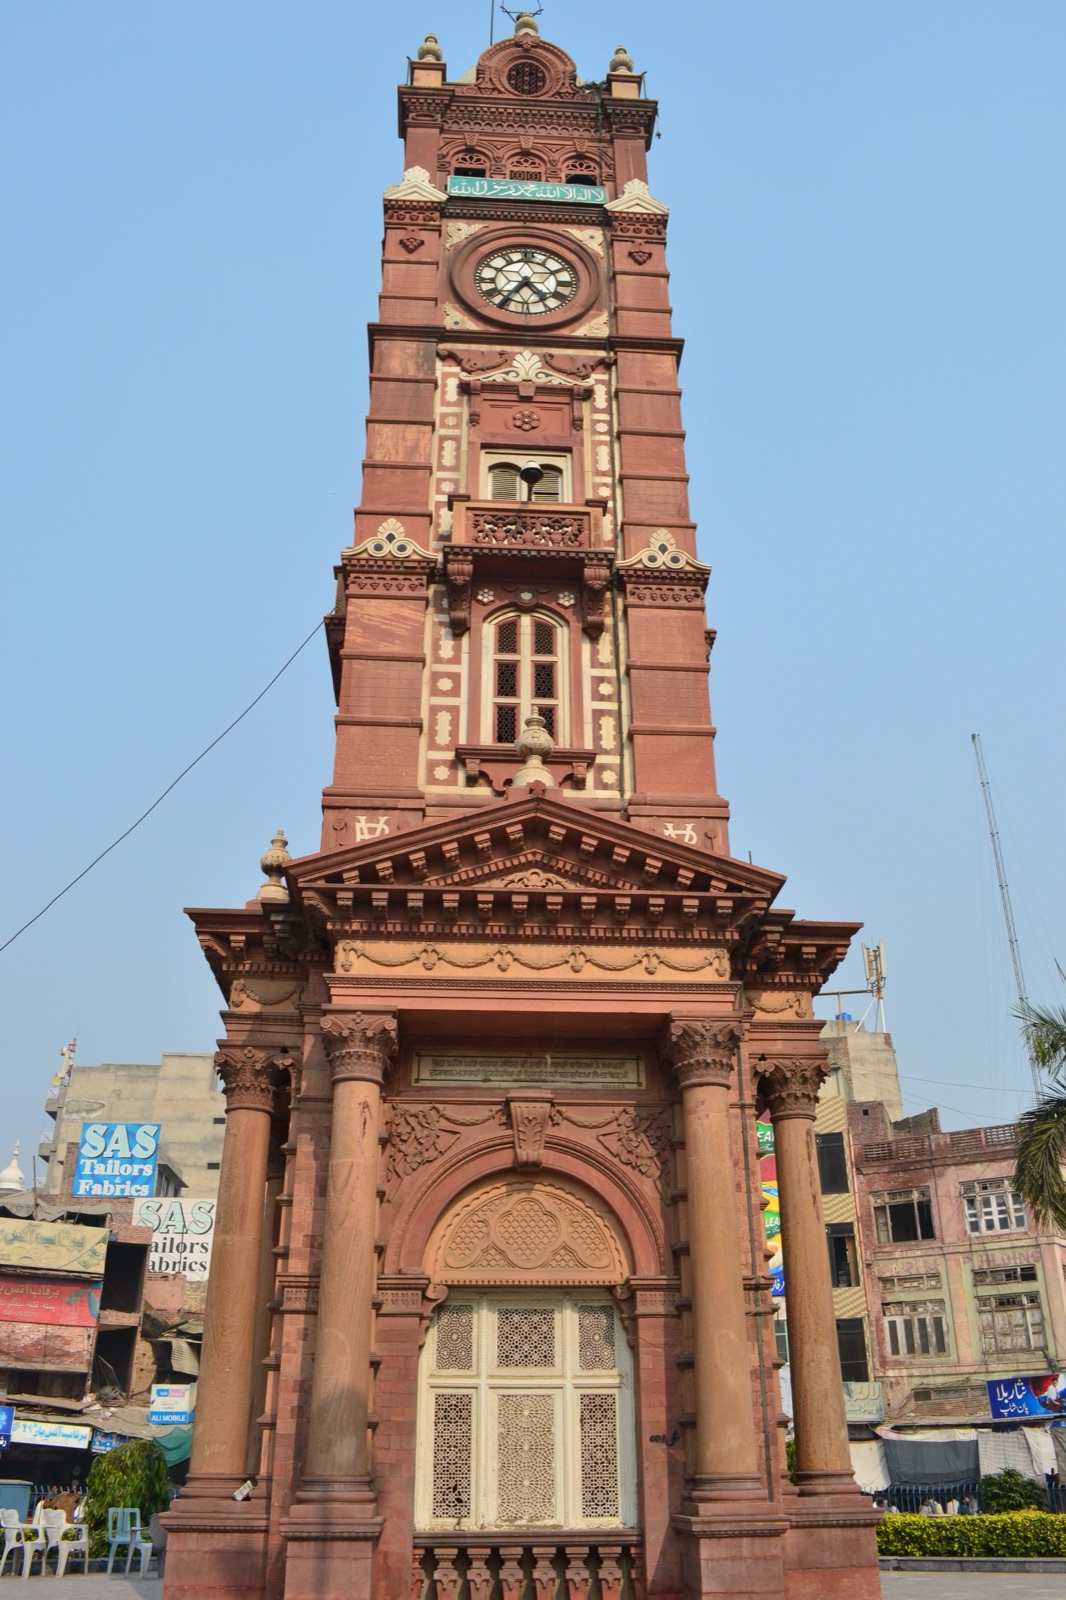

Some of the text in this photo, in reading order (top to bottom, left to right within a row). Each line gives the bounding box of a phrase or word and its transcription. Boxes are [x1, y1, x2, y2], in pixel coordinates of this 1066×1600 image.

[81, 1124, 159, 1158] SAS
[80, 1159, 152, 1176] Tailors
[77, 1180, 149, 1196] Fabrics
[136, 1200, 215, 1235] SAS
[150, 1237, 208, 1254] ailors
[149, 1256, 207, 1272] abrics
[151, 1414, 187, 1422] ALI MOBILE
